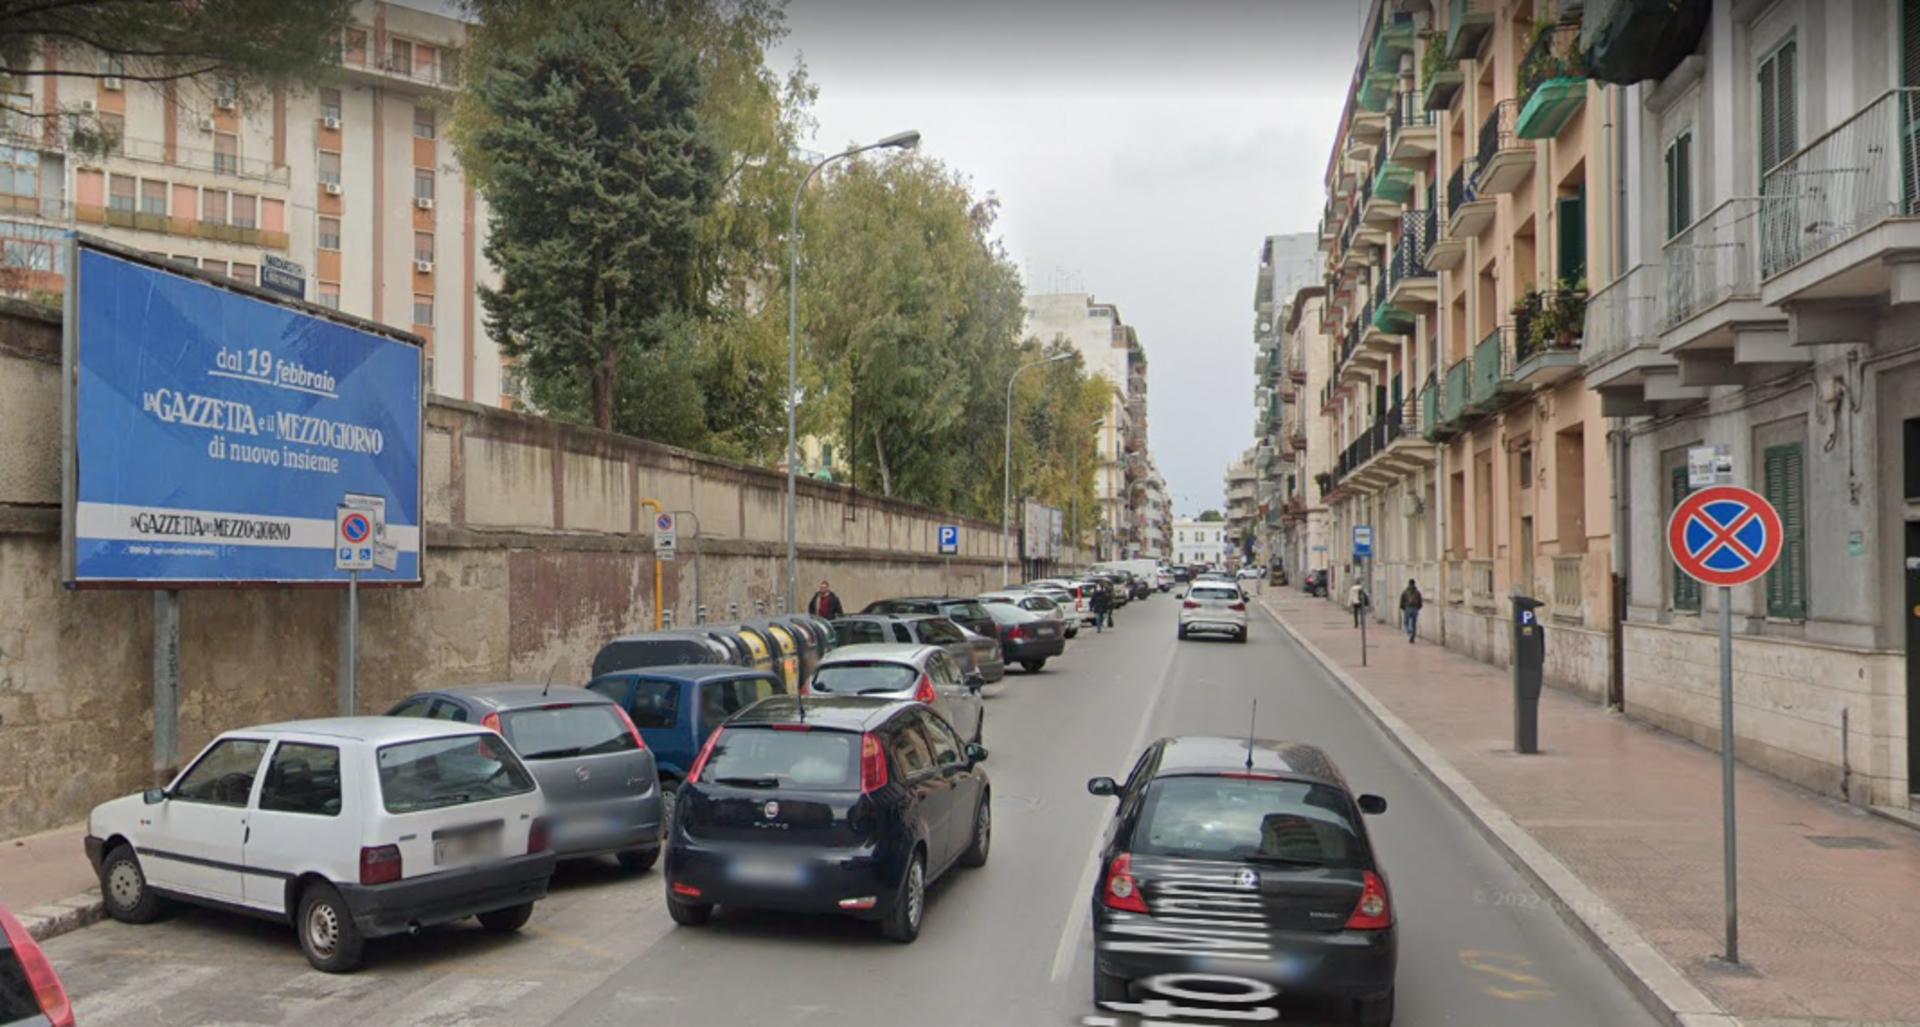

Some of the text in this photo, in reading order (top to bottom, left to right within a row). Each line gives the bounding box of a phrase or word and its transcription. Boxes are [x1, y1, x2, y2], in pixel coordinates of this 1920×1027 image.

[216, 346, 336, 392] dal 19 febbraio
[156, 388, 258, 436] GAZZETTA
[258, 417, 265, 431] e
[267, 415, 275, 432] il
[276, 411, 384, 456] MEZZOGIORNO
[208, 435, 340, 474] di nuovo insieme
[213, 517, 291, 541] MEZZOGIORNO
[942, 528, 954, 544] P
[1523, 610, 1533, 624] P
